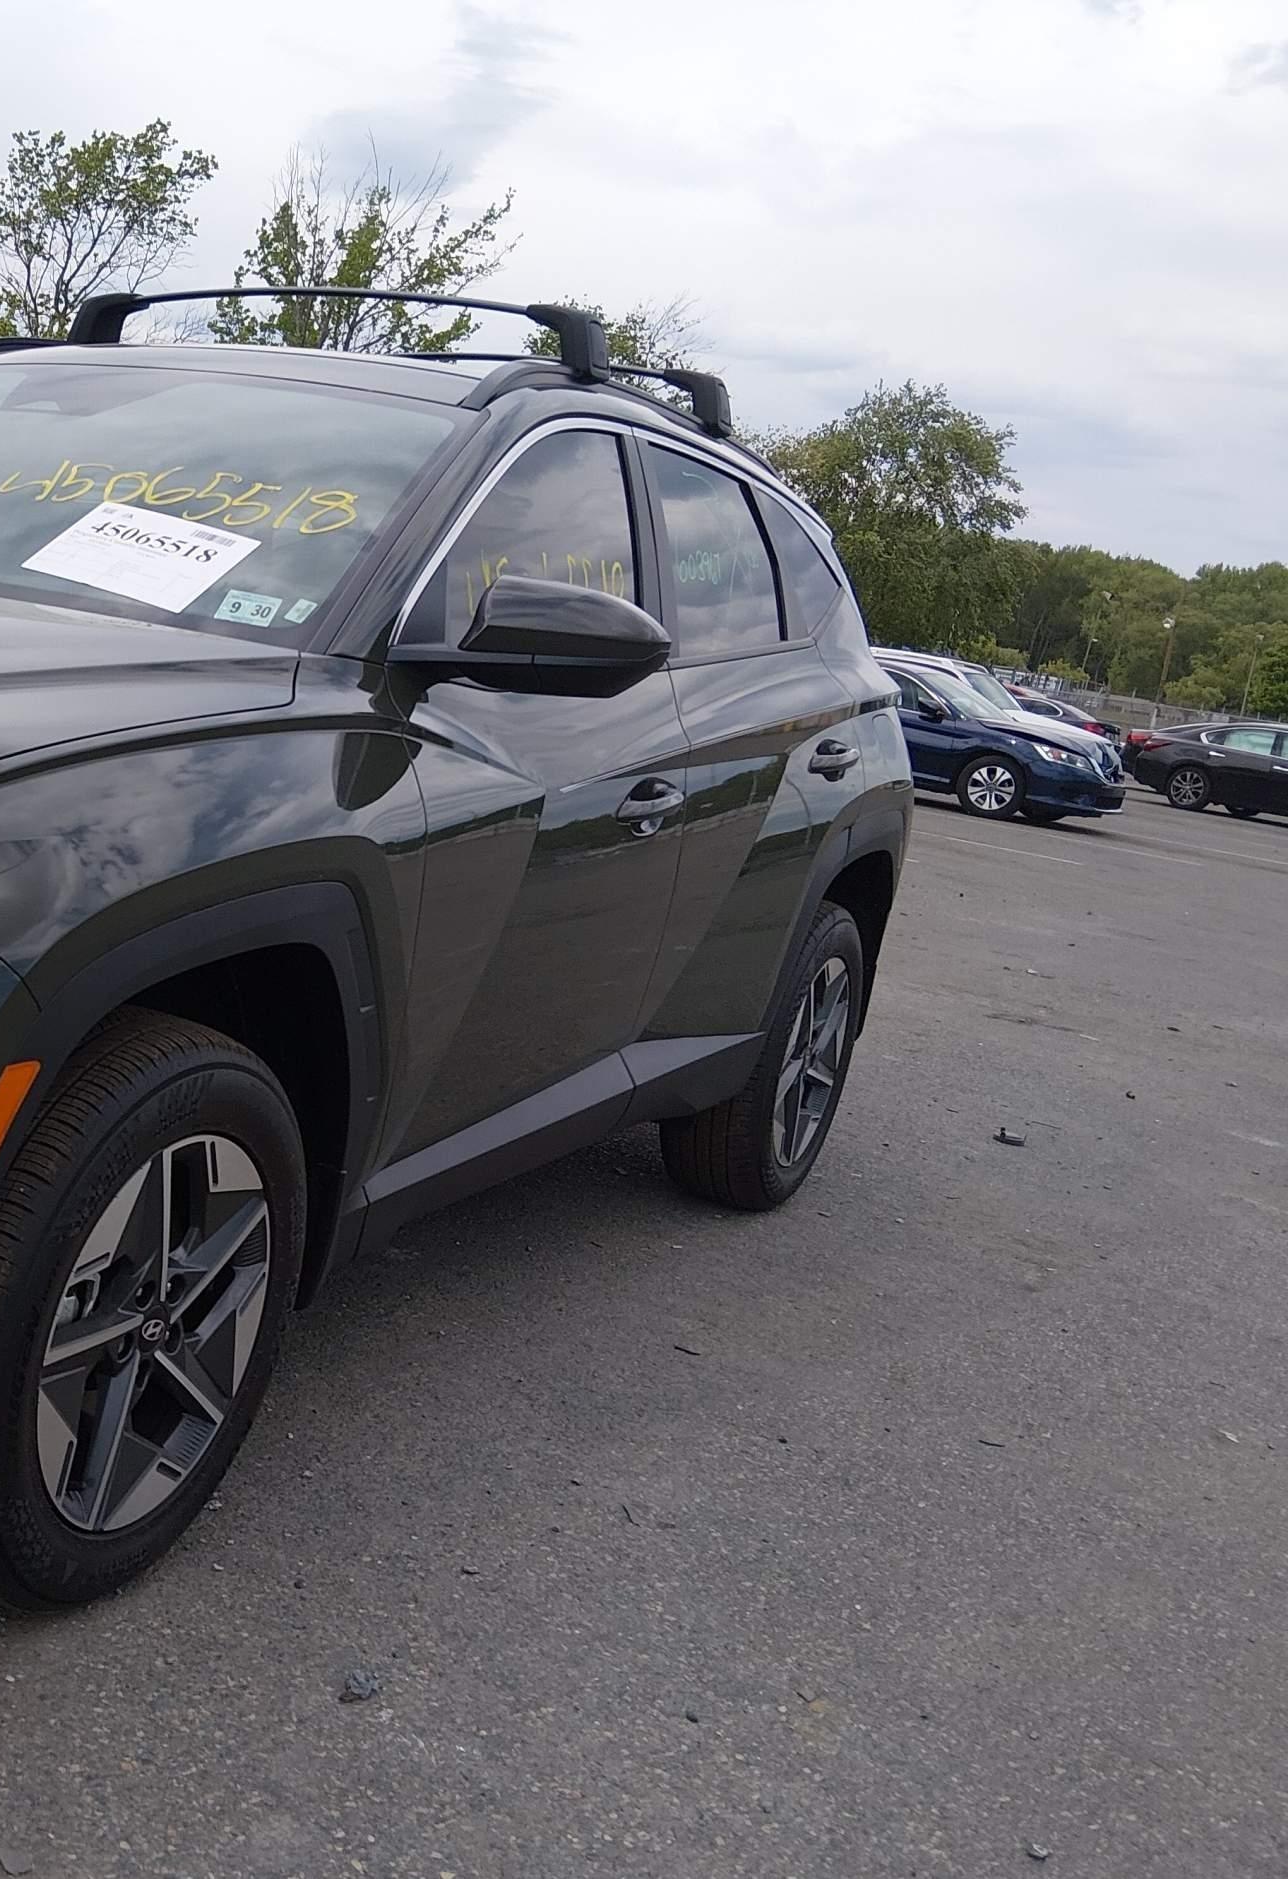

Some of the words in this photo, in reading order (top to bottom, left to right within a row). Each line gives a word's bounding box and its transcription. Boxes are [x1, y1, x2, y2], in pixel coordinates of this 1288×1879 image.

[0, 459, 360, 535] 45065518
[90, 520, 219, 565] 45065518
[228, 601, 243, 614] 9
[250, 604, 273, 619] 30
